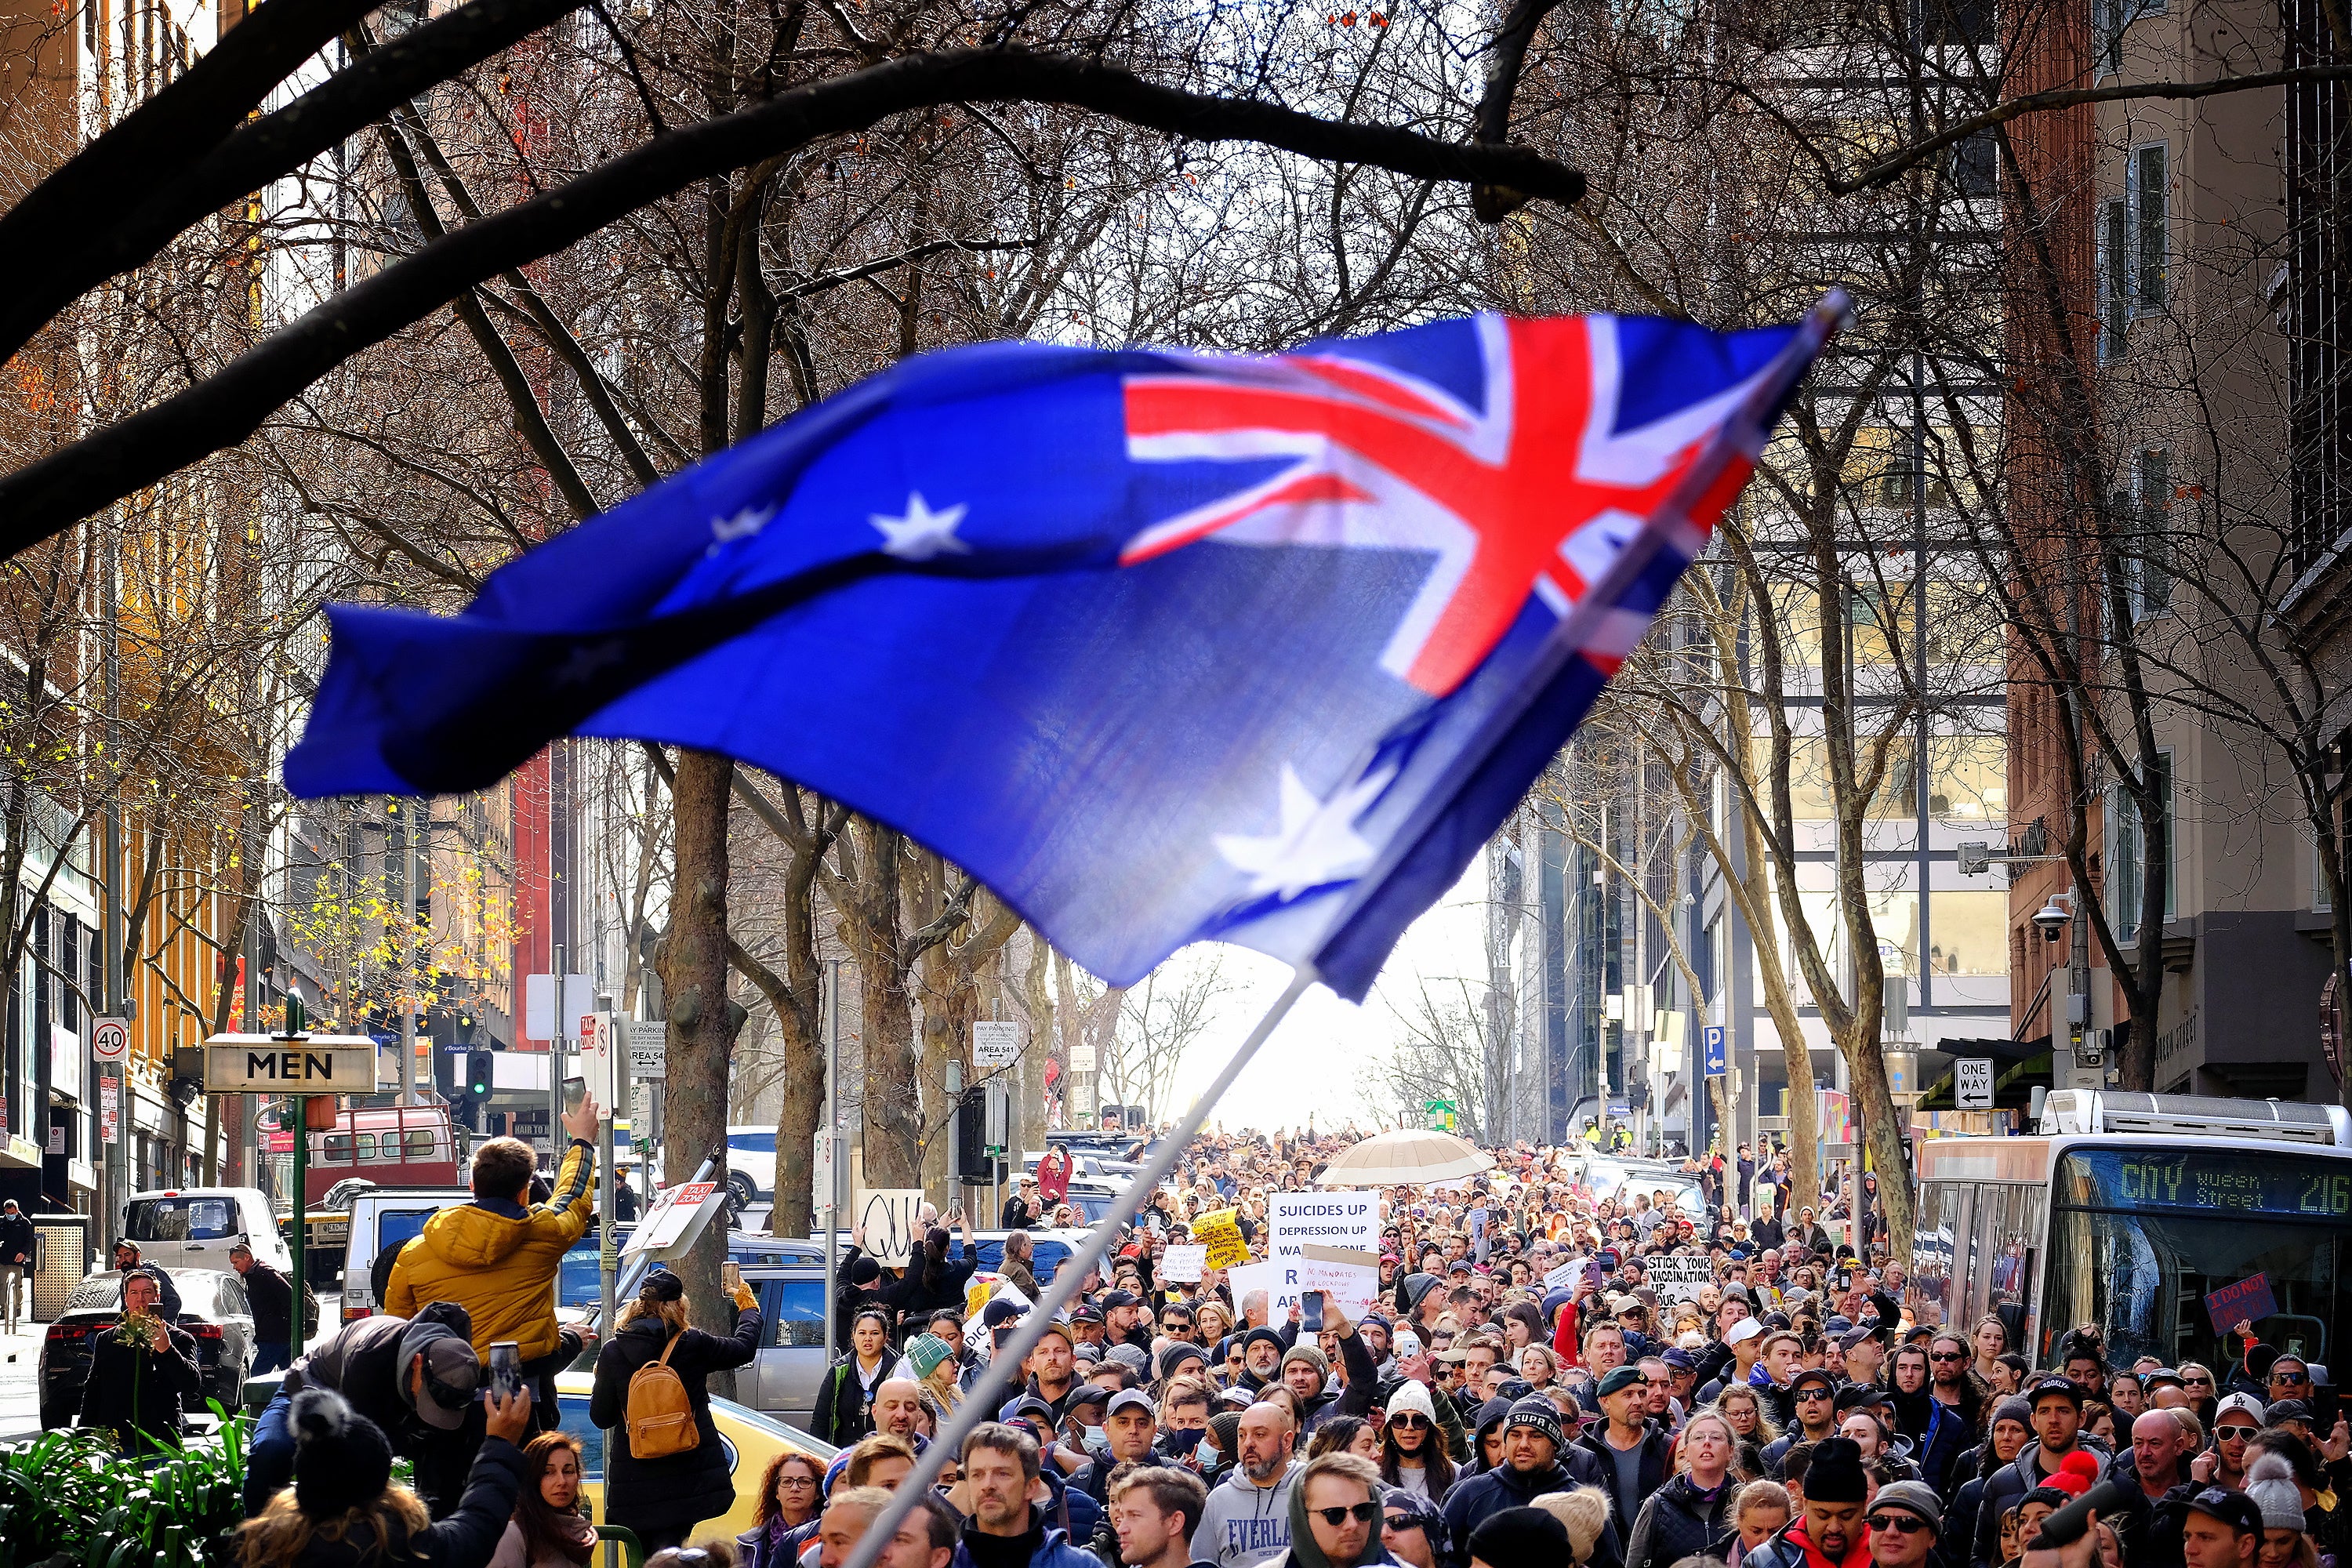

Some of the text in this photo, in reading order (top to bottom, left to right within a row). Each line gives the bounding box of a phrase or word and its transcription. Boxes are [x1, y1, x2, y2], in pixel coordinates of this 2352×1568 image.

[581, 1018, 593, 1031] TAXI
[98, 1032, 122, 1047] 40
[581, 1035, 593, 1048] ZONE
[1708, 1028, 1721, 1054] P
[248, 1052, 332, 1080] MEN
[1962, 1063, 1987, 1075] ONE
[1960, 1079, 1988, 1090] WAY
[514, 1124, 532, 1134] HAIR
[533, 1124, 543, 1134] TO
[687, 1185, 710, 1194] TAXI
[2197, 1187, 2264, 1208] Street
[1279, 1204, 1367, 1217] SUICIDES UP
[1279, 1226, 1367, 1236] DEPRESSION UP
[1648, 1257, 1711, 1269] STICK YOUR
[1650, 1270, 1711, 1283] VACCINATION
[1651, 1283, 1666, 1294] UP
[2208, 1274, 2267, 1309] I DO NOT
[1657, 1294, 1678, 1306] OUR
[2233, 1394, 2245, 1406] LA
[1227, 1516, 1291, 1552] EVERLA
